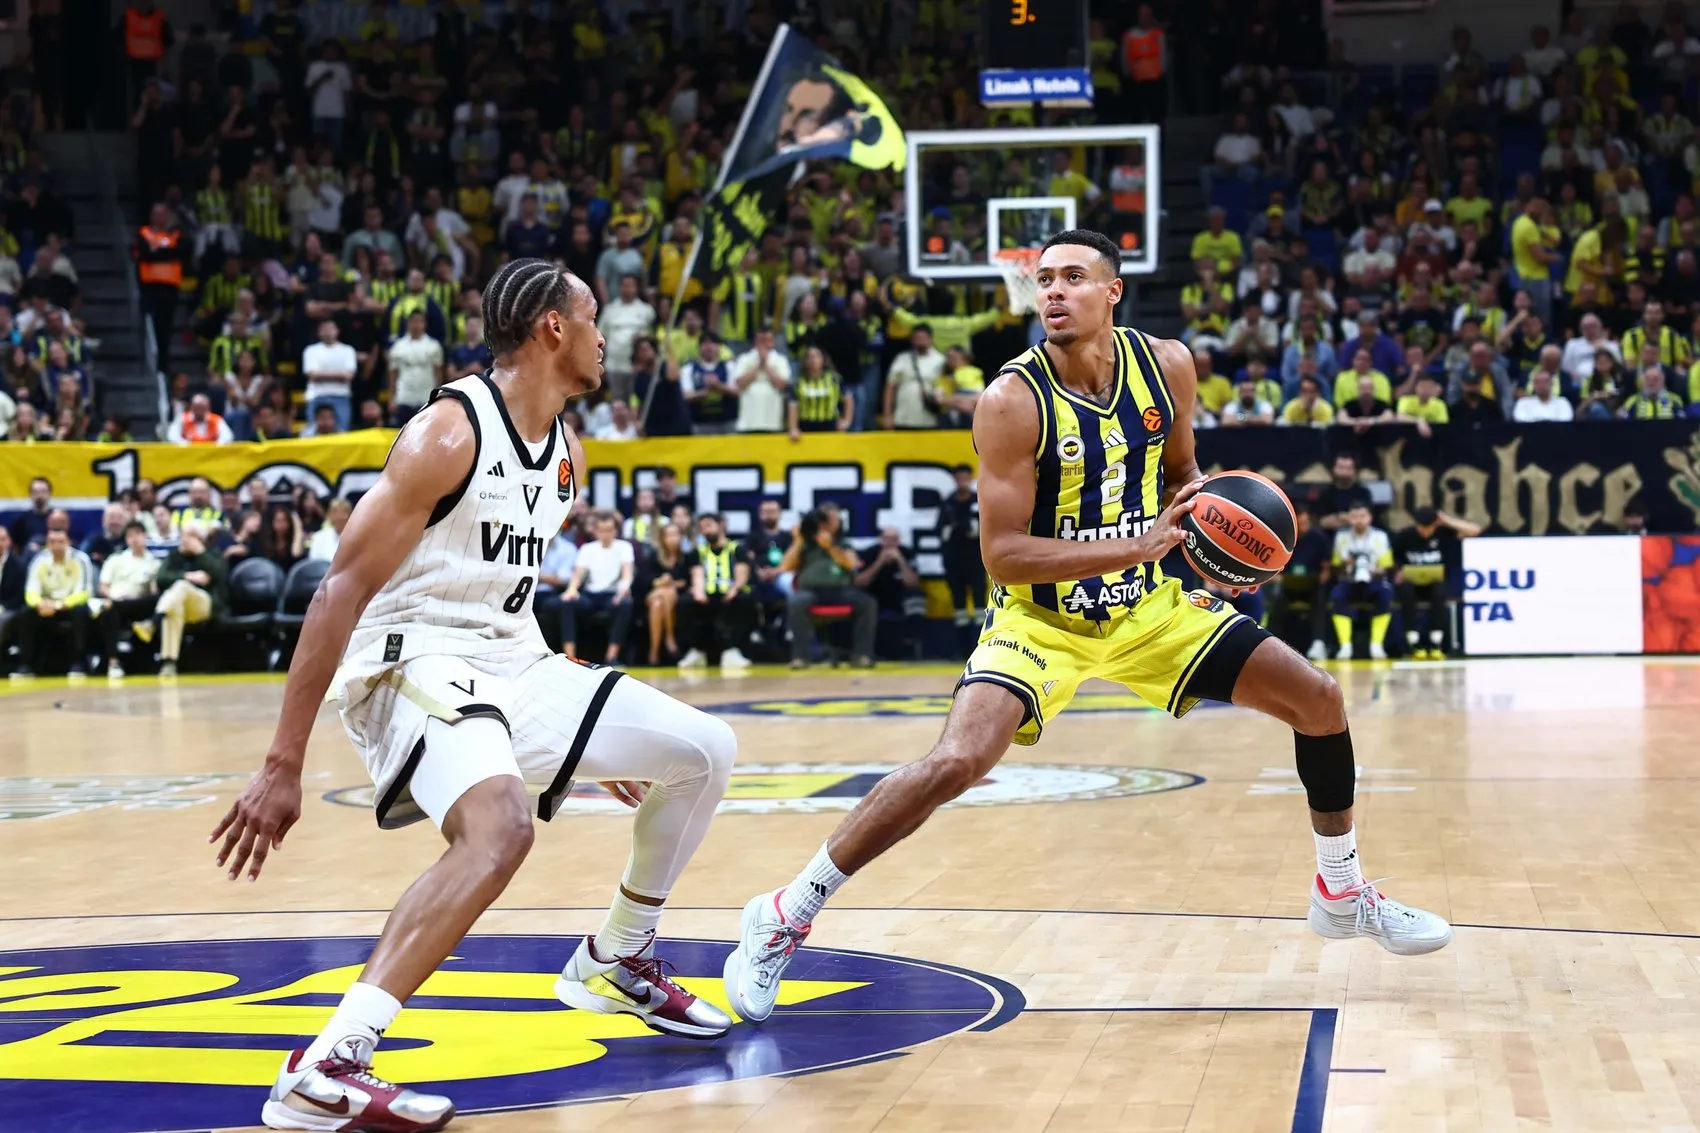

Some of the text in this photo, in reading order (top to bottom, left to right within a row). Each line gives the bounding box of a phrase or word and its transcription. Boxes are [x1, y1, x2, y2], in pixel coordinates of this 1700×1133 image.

[985, 78, 1032, 95] Limak
[1033, 76, 1081, 93] Hotels
[1100, 461, 1127, 505] 2
[1201, 504, 1275, 566] SPALDING
[503, 576, 534, 614] 8
[988, 637, 1048, 671] Limak Hotels
